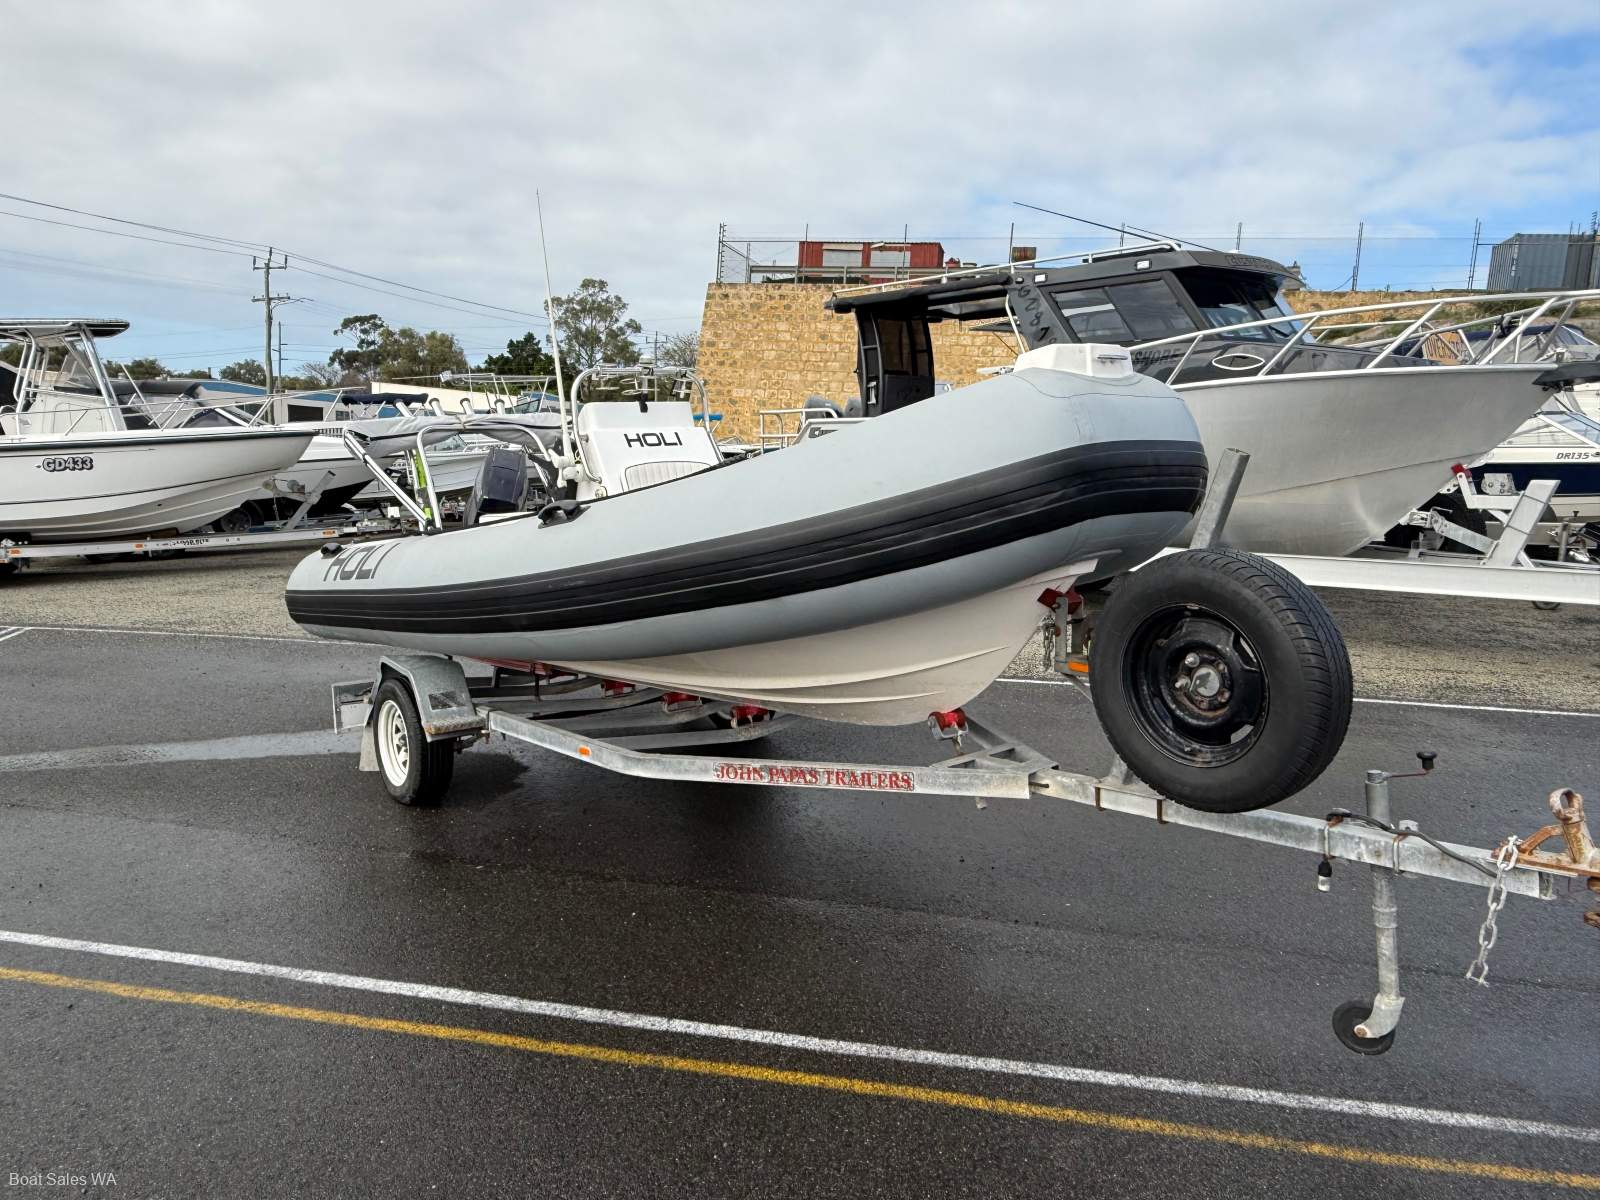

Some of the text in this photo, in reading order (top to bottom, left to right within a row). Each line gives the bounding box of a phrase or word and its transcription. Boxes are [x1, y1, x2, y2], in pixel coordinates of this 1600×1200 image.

[624, 432, 683, 447] HOLI
[42, 456, 94, 472] GD433
[323, 543, 401, 582] HOLI
[716, 764, 914, 791] JOHN PAPAS TRAILERS
